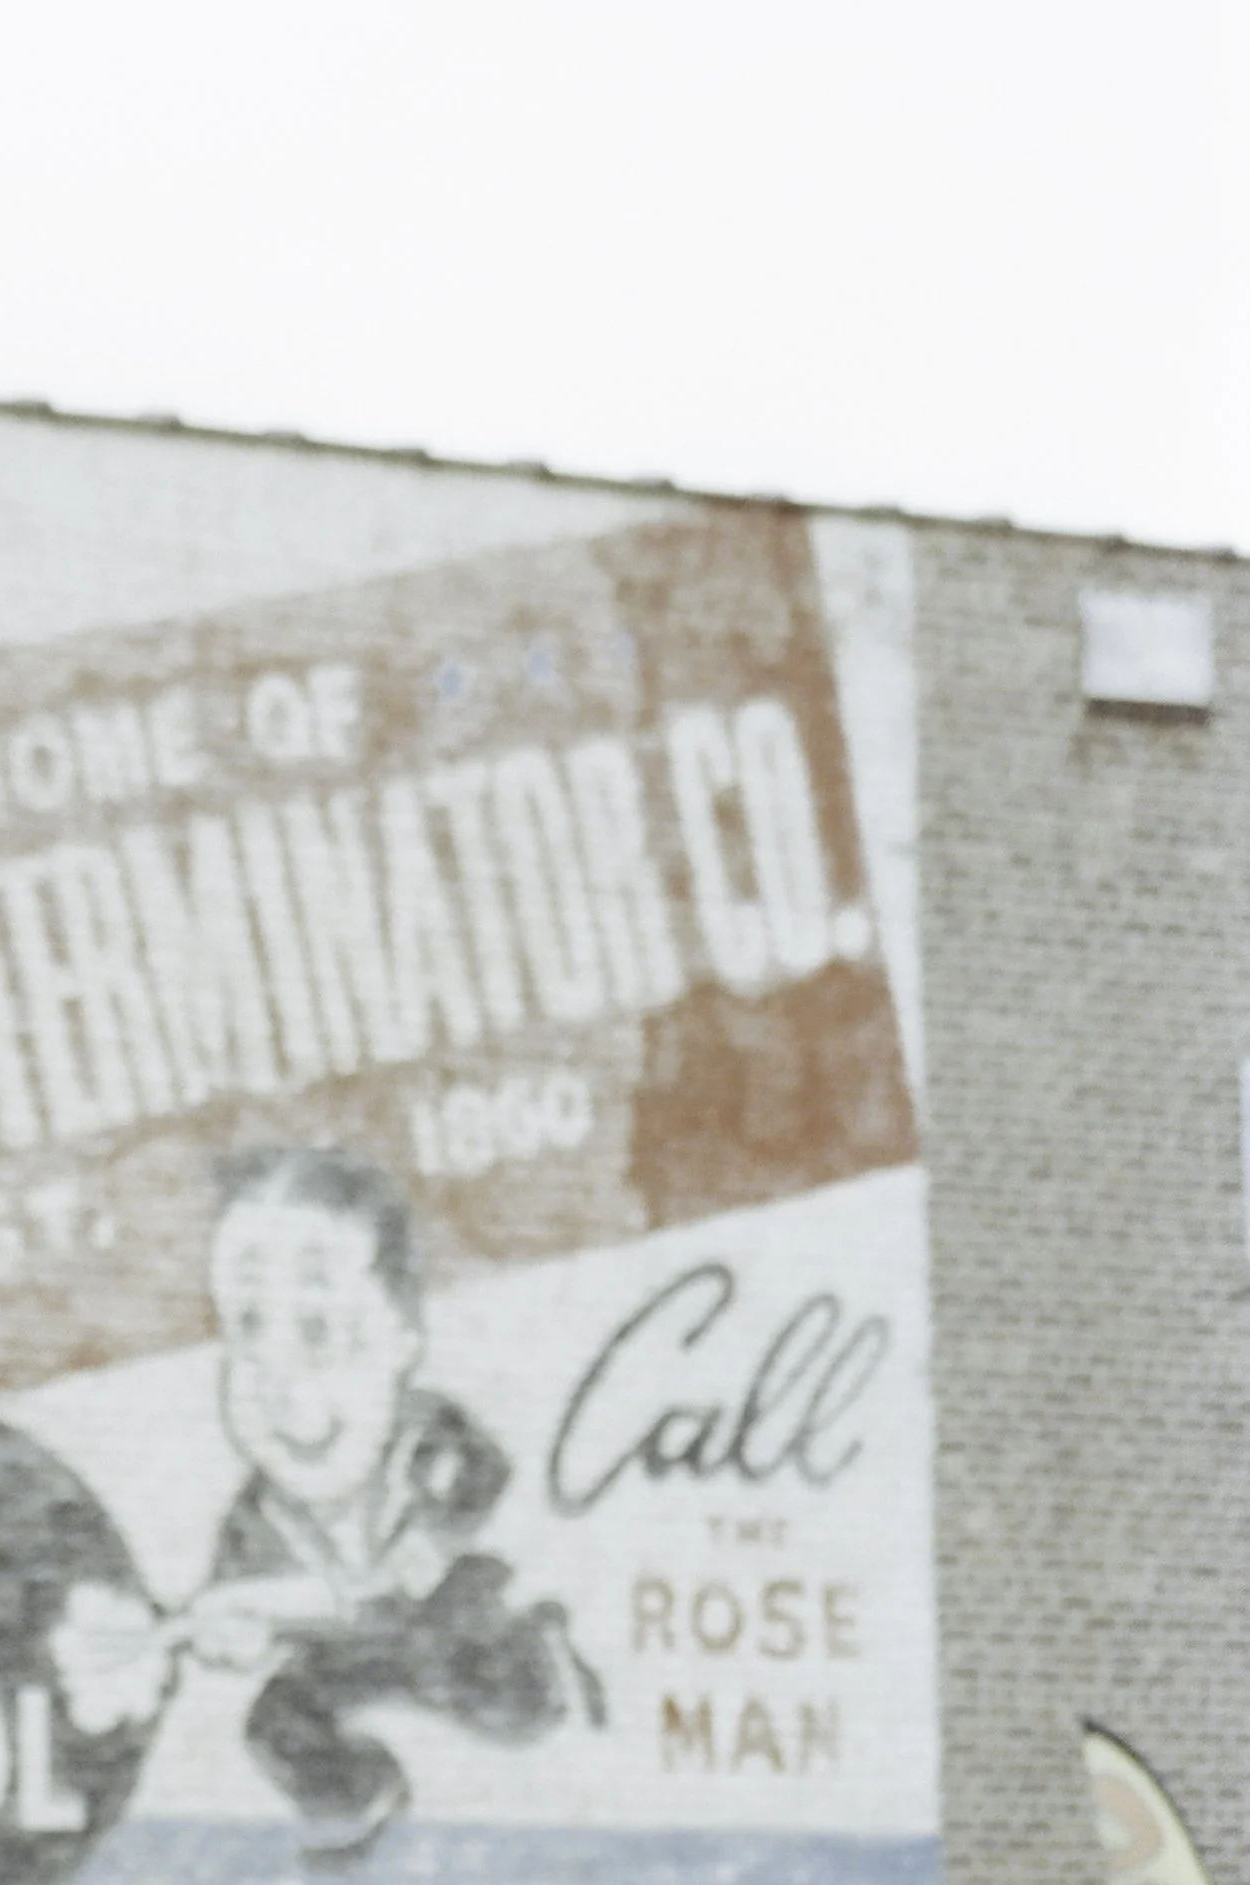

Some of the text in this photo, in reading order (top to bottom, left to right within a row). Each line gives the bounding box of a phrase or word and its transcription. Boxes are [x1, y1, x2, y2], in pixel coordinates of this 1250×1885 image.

[249, 662, 358, 764] OF
[666, 697, 870, 998] CO.
[411, 1073, 594, 1173] 1860
[548, 1264, 892, 1518] Call
[704, 1513, 791, 1551] THE
[630, 1578, 862, 1662] ROSE
[658, 1692, 842, 1776] MAN
